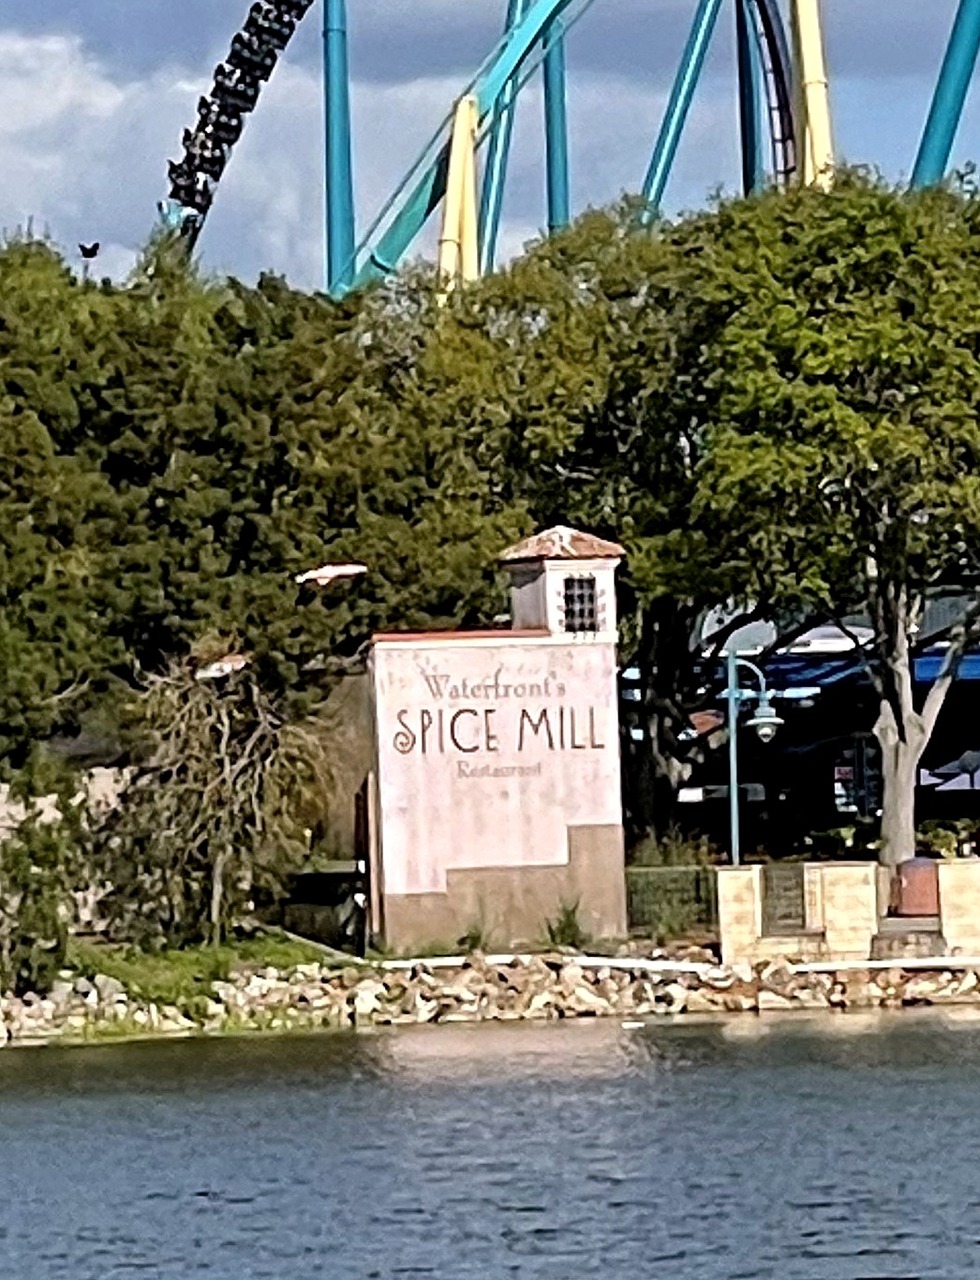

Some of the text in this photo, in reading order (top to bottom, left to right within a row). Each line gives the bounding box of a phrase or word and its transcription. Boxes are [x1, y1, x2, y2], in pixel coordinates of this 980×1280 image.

[424, 665, 566, 701] Waterfront's
[393, 706, 605, 755] SPICE MILL
[456, 760, 542, 779] Restaurant
